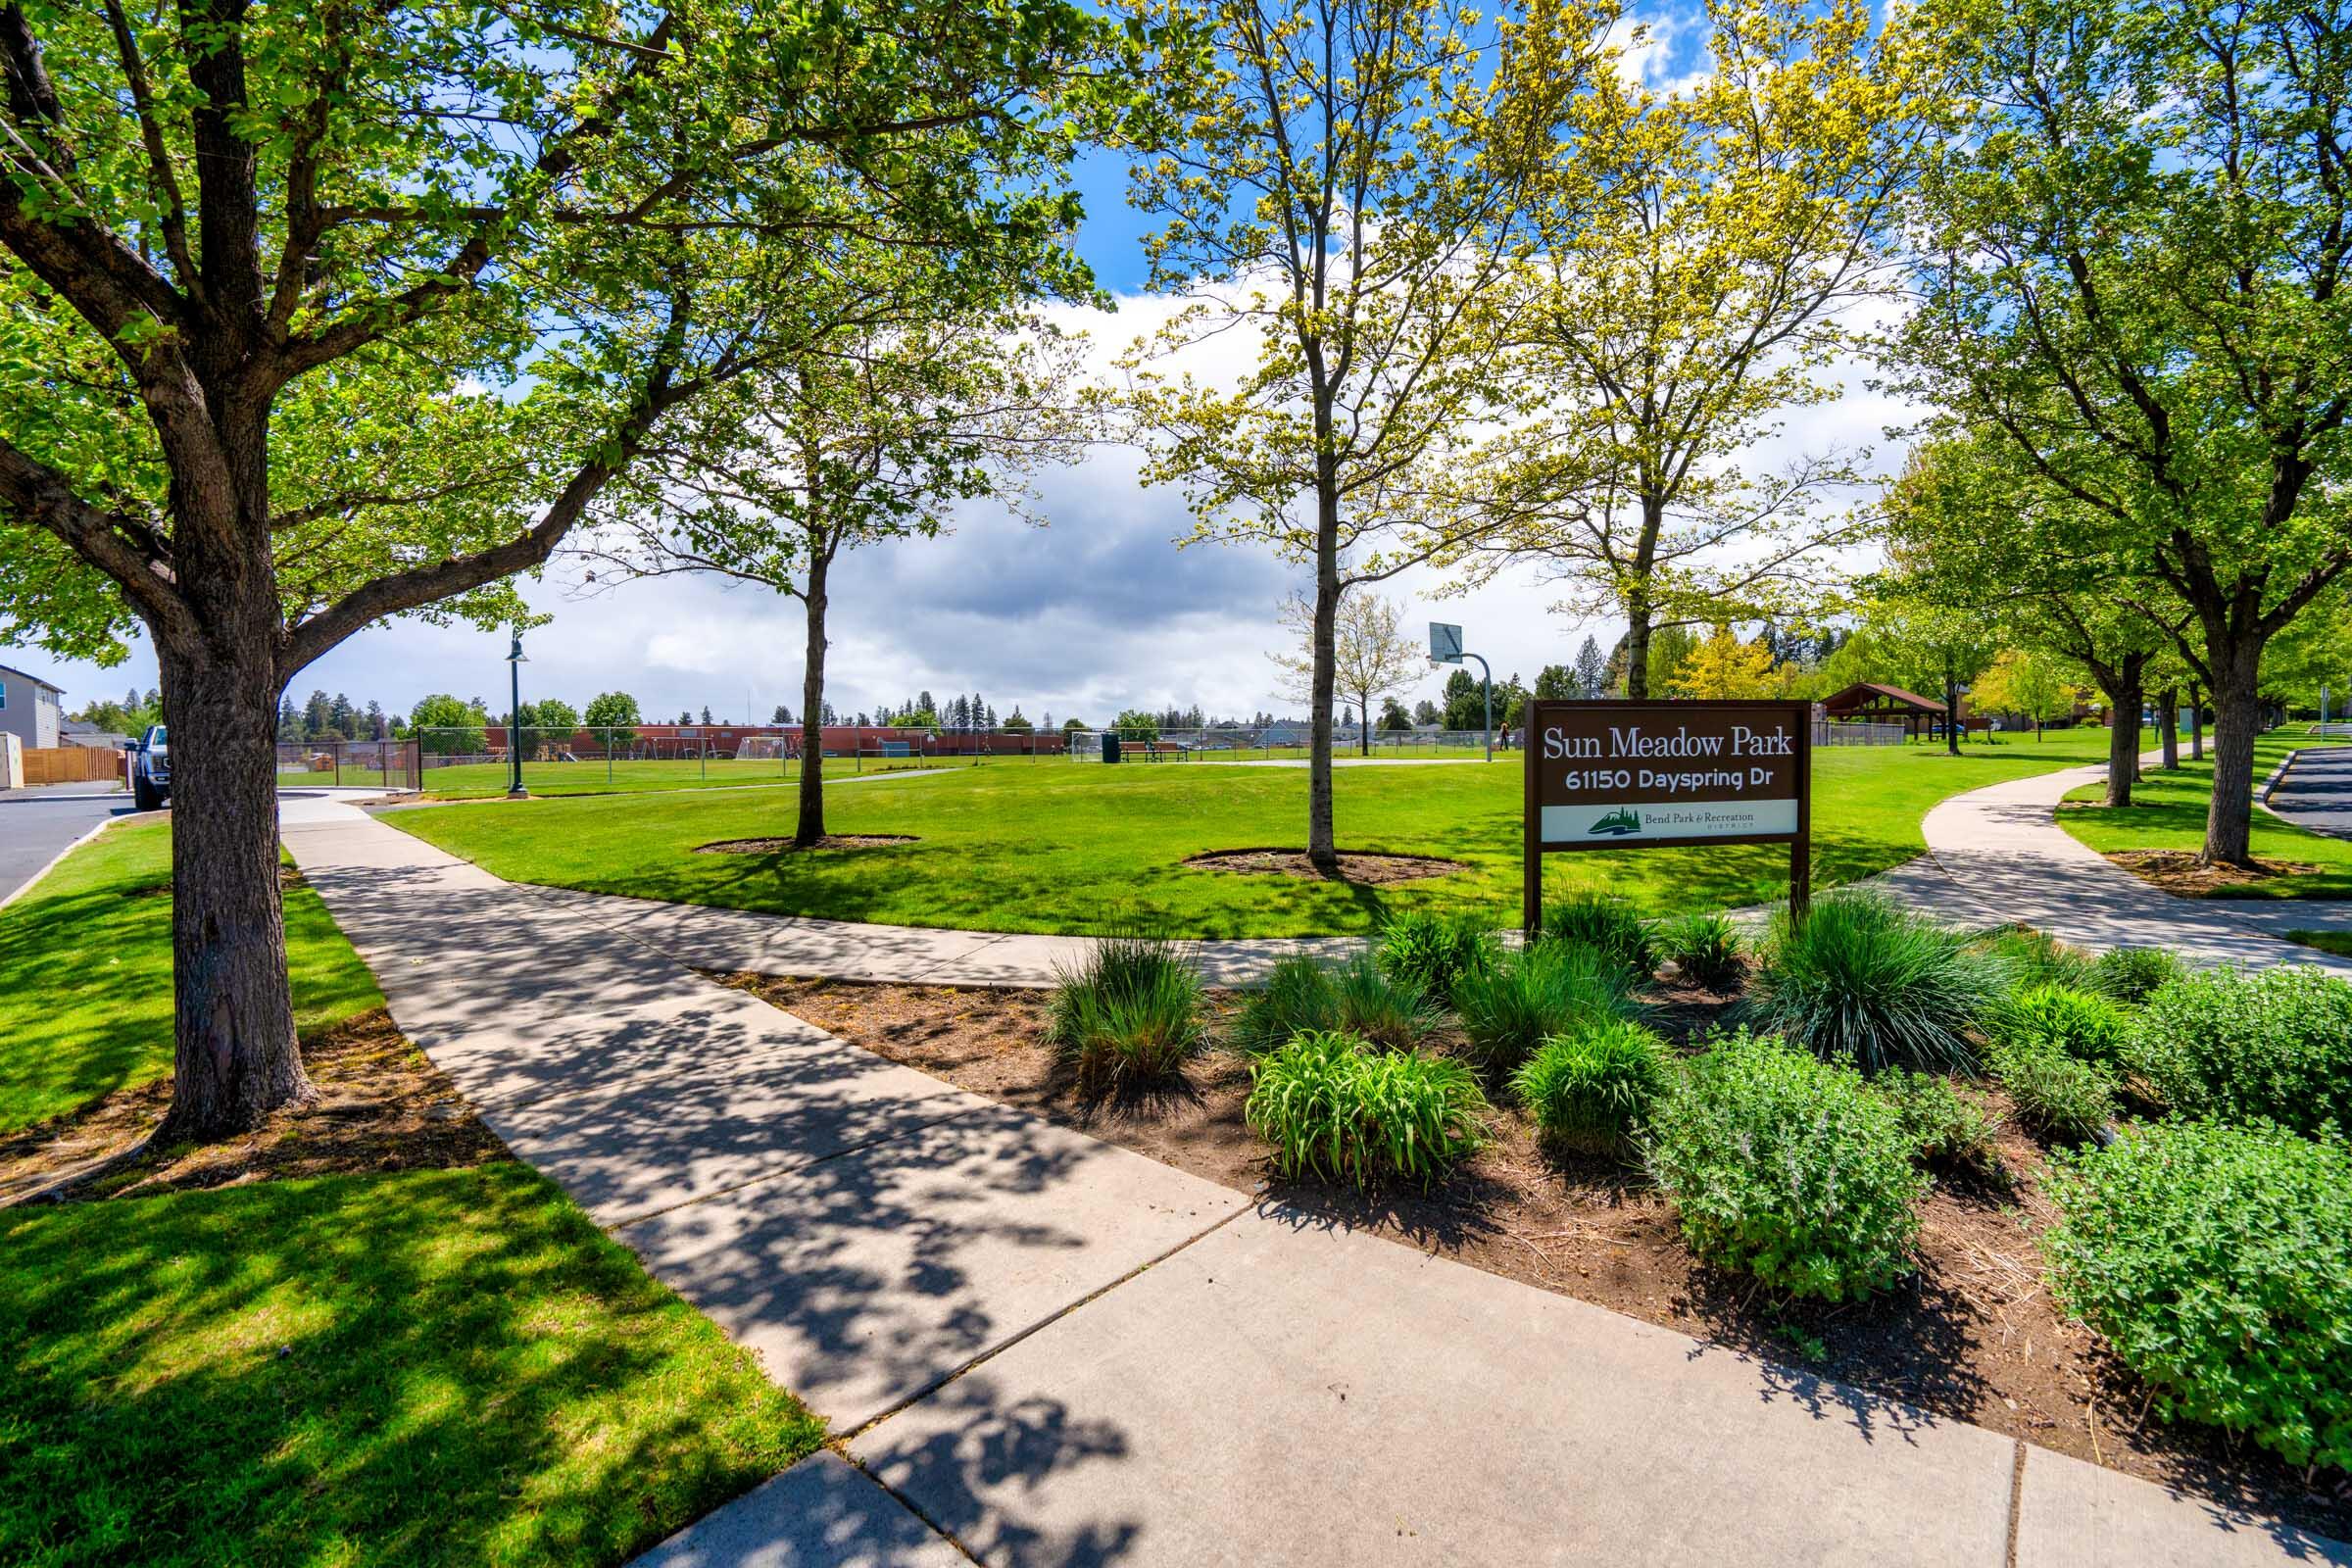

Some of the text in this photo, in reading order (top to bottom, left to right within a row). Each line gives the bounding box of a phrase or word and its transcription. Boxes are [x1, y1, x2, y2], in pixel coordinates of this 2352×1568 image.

[1544, 725, 1794, 760] Sun Meadow Park
[1565, 767, 1774, 793] 61150 Dayspring Dr
[1645, 811, 1754, 824] Bend Park & Recreation
